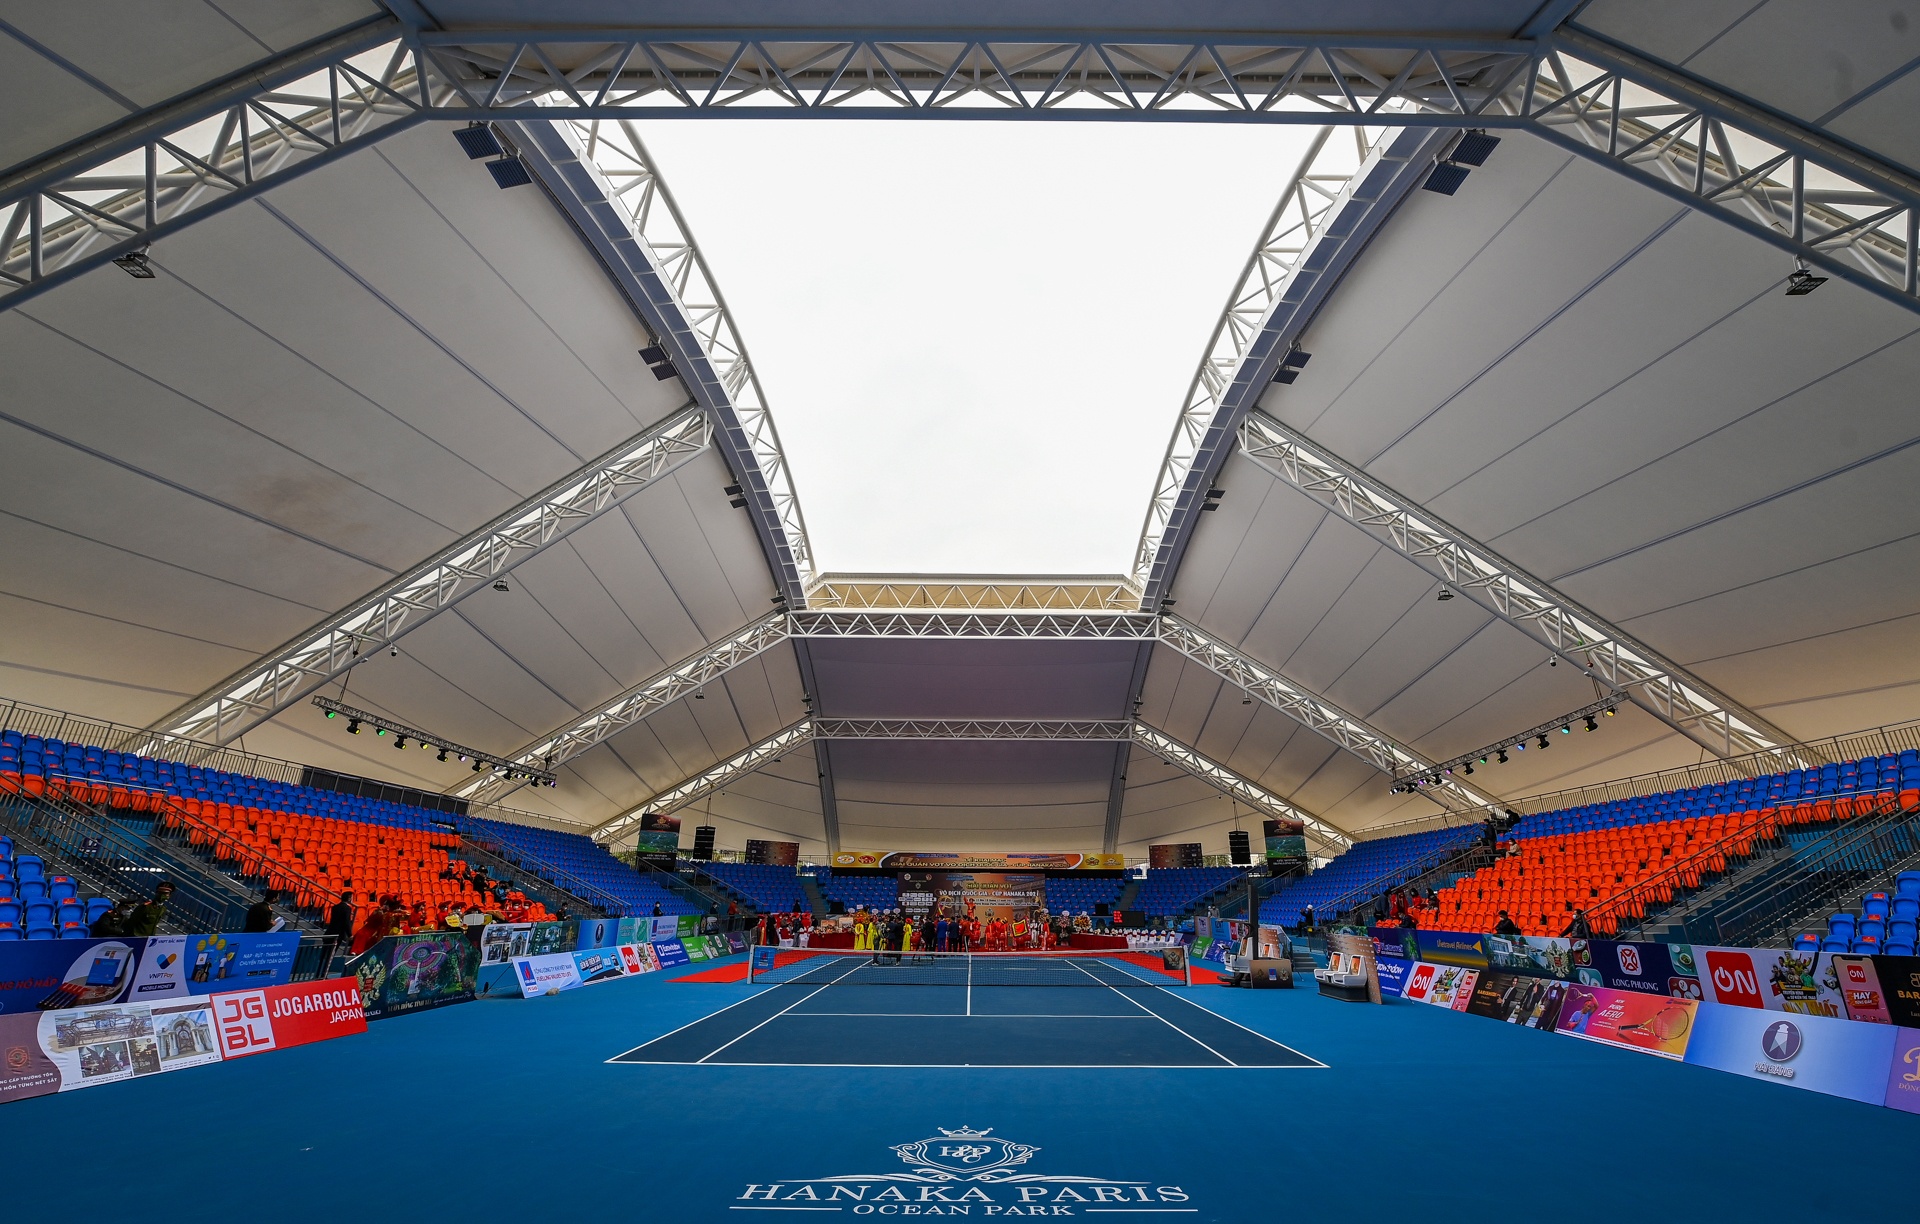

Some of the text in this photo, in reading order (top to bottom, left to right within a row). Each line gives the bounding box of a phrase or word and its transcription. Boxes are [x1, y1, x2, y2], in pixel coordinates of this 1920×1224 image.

[1714, 966, 1757, 995] ON
[1849, 969, 1864, 979] ON
[1612, 978, 1630, 988] LONG
[272, 988, 361, 1018] JOGARBOLA
[1853, 991, 1871, 1000] HAY
[223, 996, 264, 1023] JG
[1598, 1009, 1625, 1019] AERO
[1608, 1003, 1625, 1011] PURE
[329, 1007, 364, 1024] JAPAN
[225, 1023, 269, 1050] BL
[736, 1184, 1191, 1203] HANAKA PARIS
[853, 1203, 1076, 1217] OCEAN PARK
